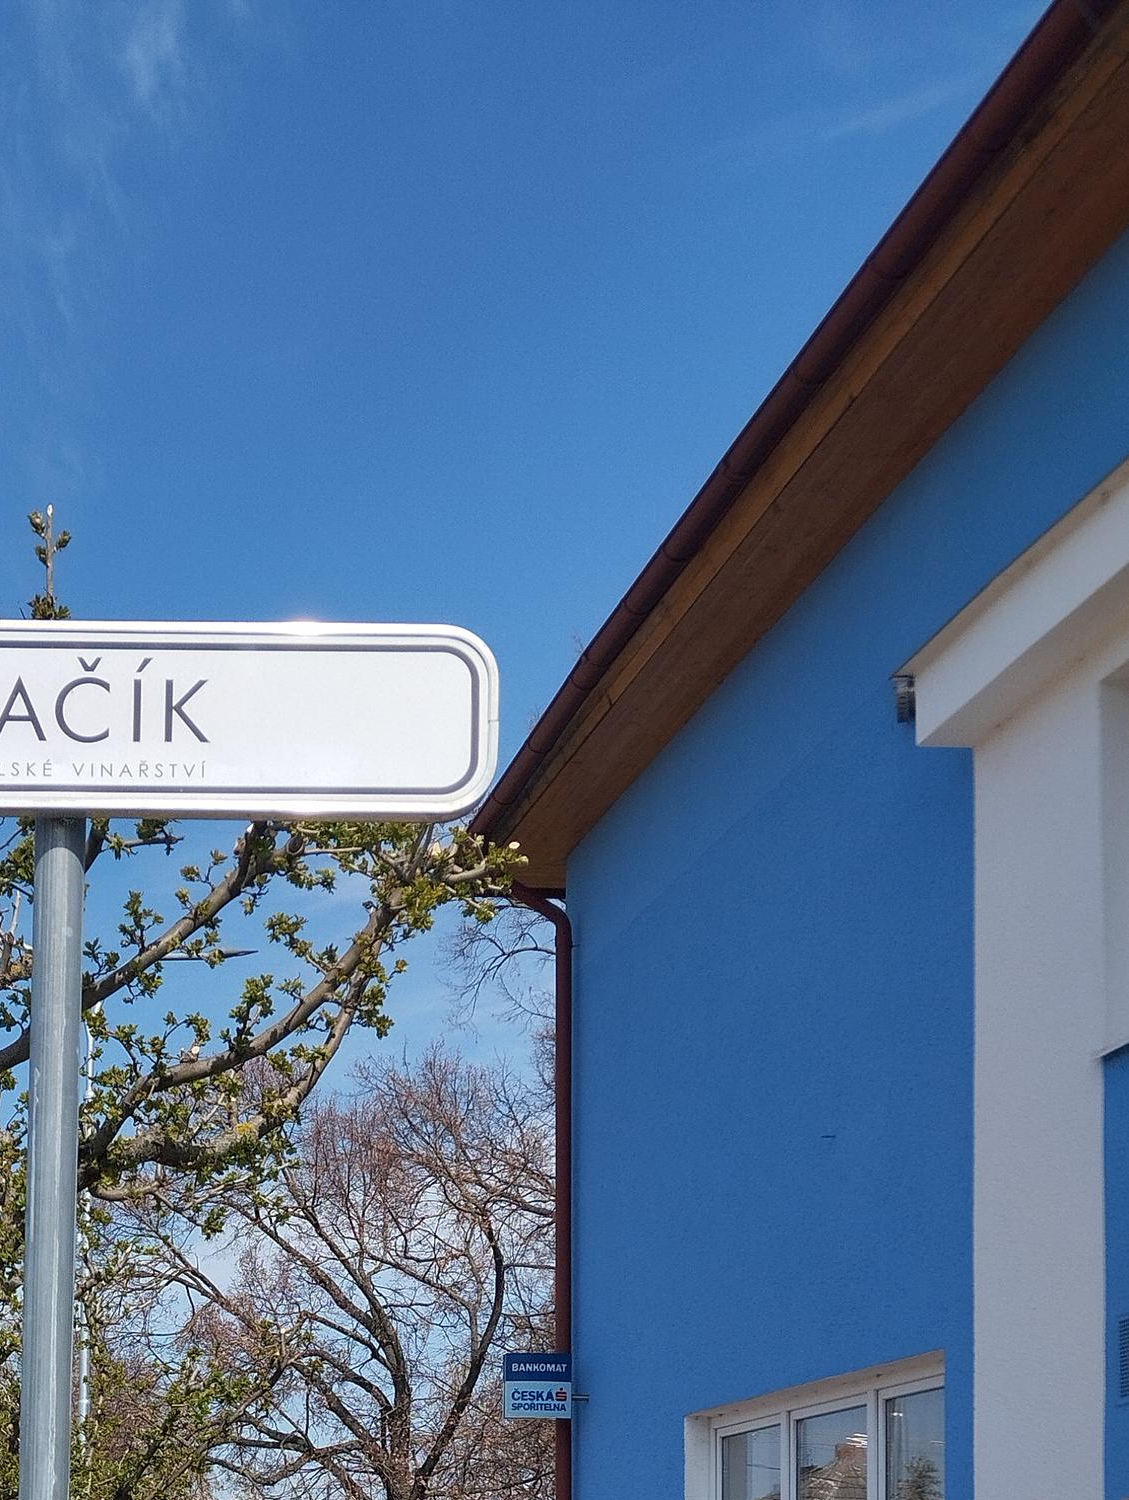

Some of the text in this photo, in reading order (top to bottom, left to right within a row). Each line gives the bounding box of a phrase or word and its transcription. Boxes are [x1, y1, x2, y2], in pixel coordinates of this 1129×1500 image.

[72, 760, 207, 778] VINAŘSTVÍ
[511, 1363, 567, 1372] BANKOMAT
[511, 1388, 554, 1401] ČESKÁ
